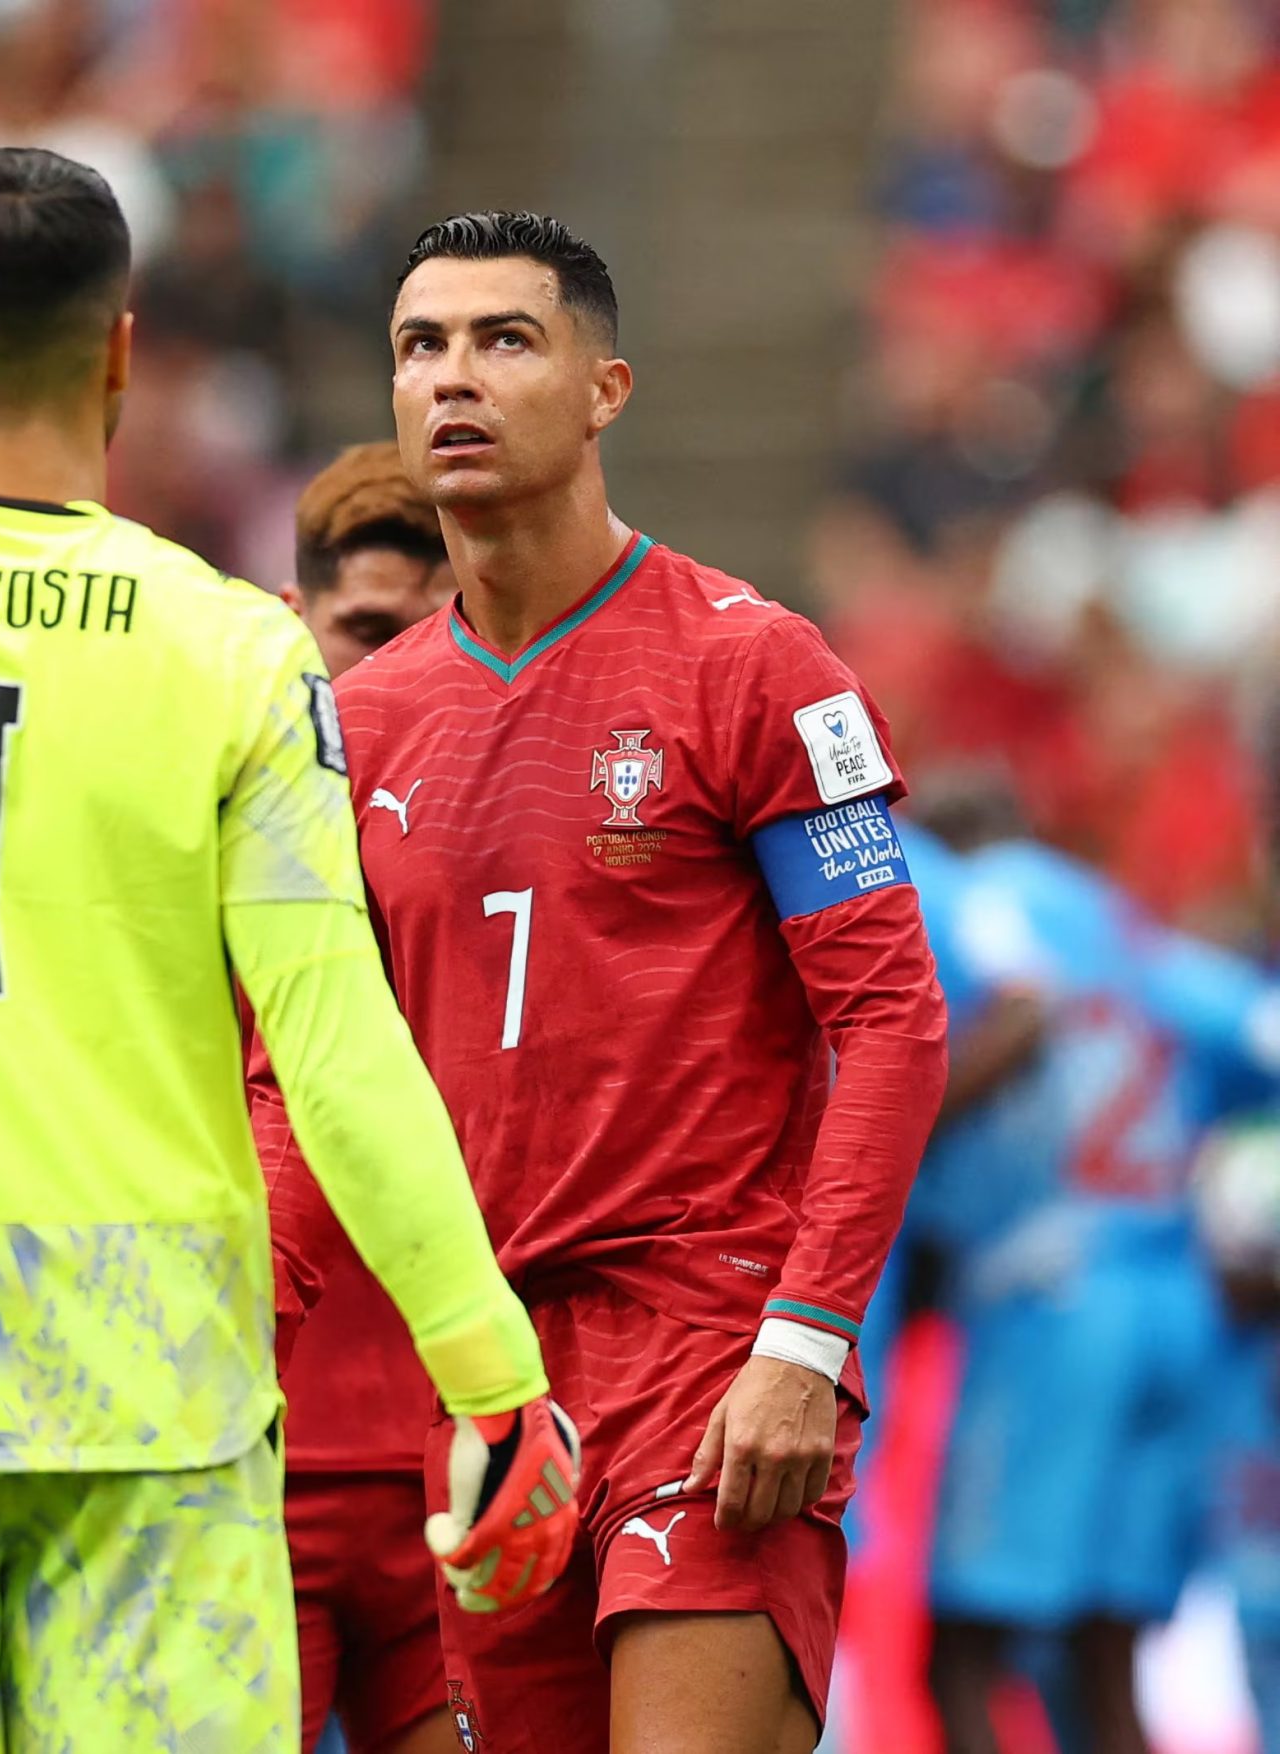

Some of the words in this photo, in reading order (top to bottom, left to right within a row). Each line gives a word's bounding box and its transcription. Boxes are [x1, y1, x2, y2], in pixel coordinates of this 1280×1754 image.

[835, 753, 867, 777] PEACE
[847, 773, 866, 785] FIFA
[804, 799, 882, 836] FOOTBALL
[811, 817, 893, 858] UNITES
[593, 846, 602, 856] 17
[605, 853, 651, 866] HOUSTON
[819, 858, 857, 881] the
[856, 842, 904, 868] World
[859, 867, 893, 887] FIFA
[482, 887, 533, 1050] 7
